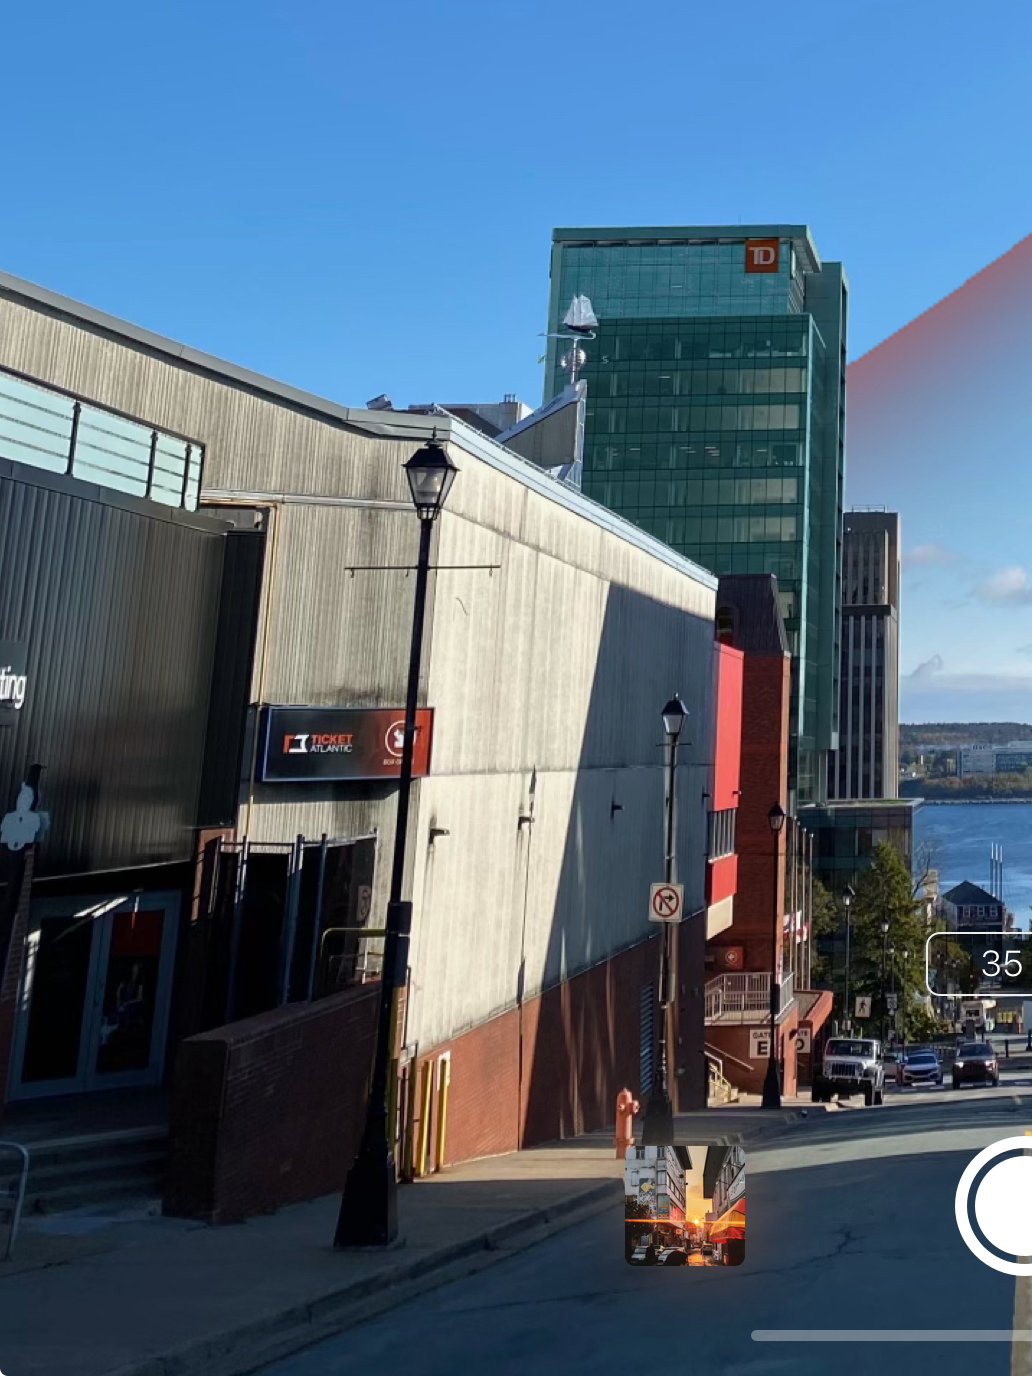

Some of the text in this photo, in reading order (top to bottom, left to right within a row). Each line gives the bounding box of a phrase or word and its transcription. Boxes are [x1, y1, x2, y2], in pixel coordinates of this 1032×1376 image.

[747, 246, 775, 265] TD
[310, 734, 354, 744] TICKET
[309, 744, 353, 753] ATLANTIC
[756, 1040, 768, 1056] E
